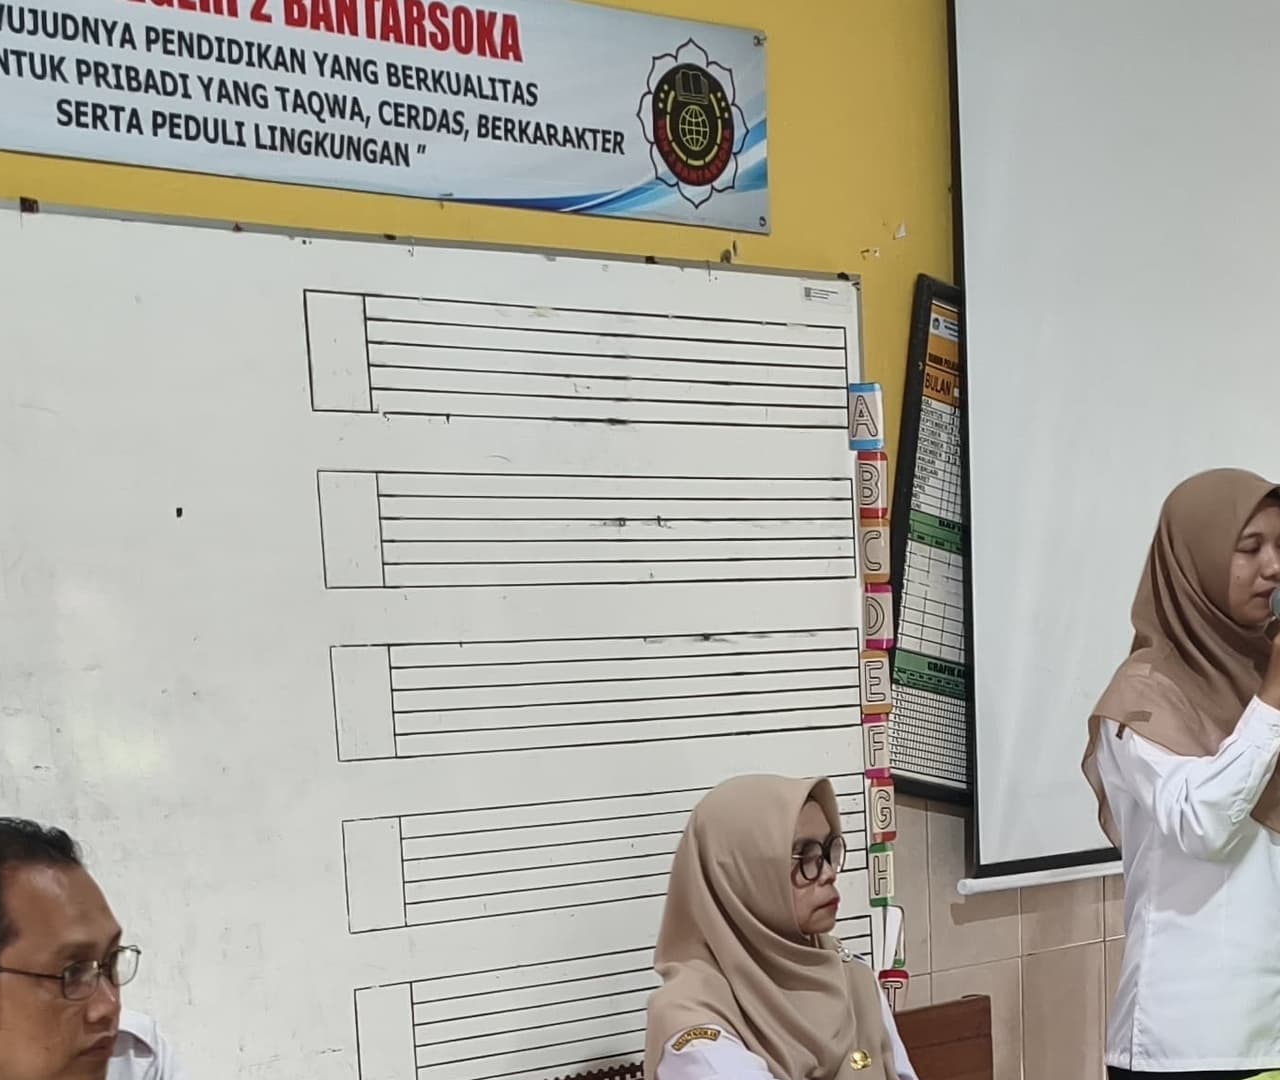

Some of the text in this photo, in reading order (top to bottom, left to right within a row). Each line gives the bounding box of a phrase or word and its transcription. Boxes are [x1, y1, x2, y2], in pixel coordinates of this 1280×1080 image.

[284, 0, 523, 62] BANTARSOKA
[146, 25, 306, 74] PENDIDIKAN
[313, 51, 379, 84] YANG
[386, 62, 539, 106] BERKUALITAS
[75, 58, 193, 99] PRIBADI
[197, 75, 268, 109] YANG
[274, 85, 371, 128] TAQWA,
[378, 100, 469, 141] CERDAS,
[477, 113, 626, 155] BERKARAKTER
[56, 98, 143, 135] SERTA
[152, 110, 246, 147] PEDULI
[254, 122, 411, 167] LINGKUNGAN
[925, 371, 951, 394] BULAN
[852, 395, 880, 440] A
[858, 462, 880, 507] B
[864, 529, 881, 572] C
[867, 596, 885, 635] D
[866, 660, 885, 702] E
[868, 726, 883, 767] F
[873, 789, 892, 830] G
[873, 855, 890, 895] H
